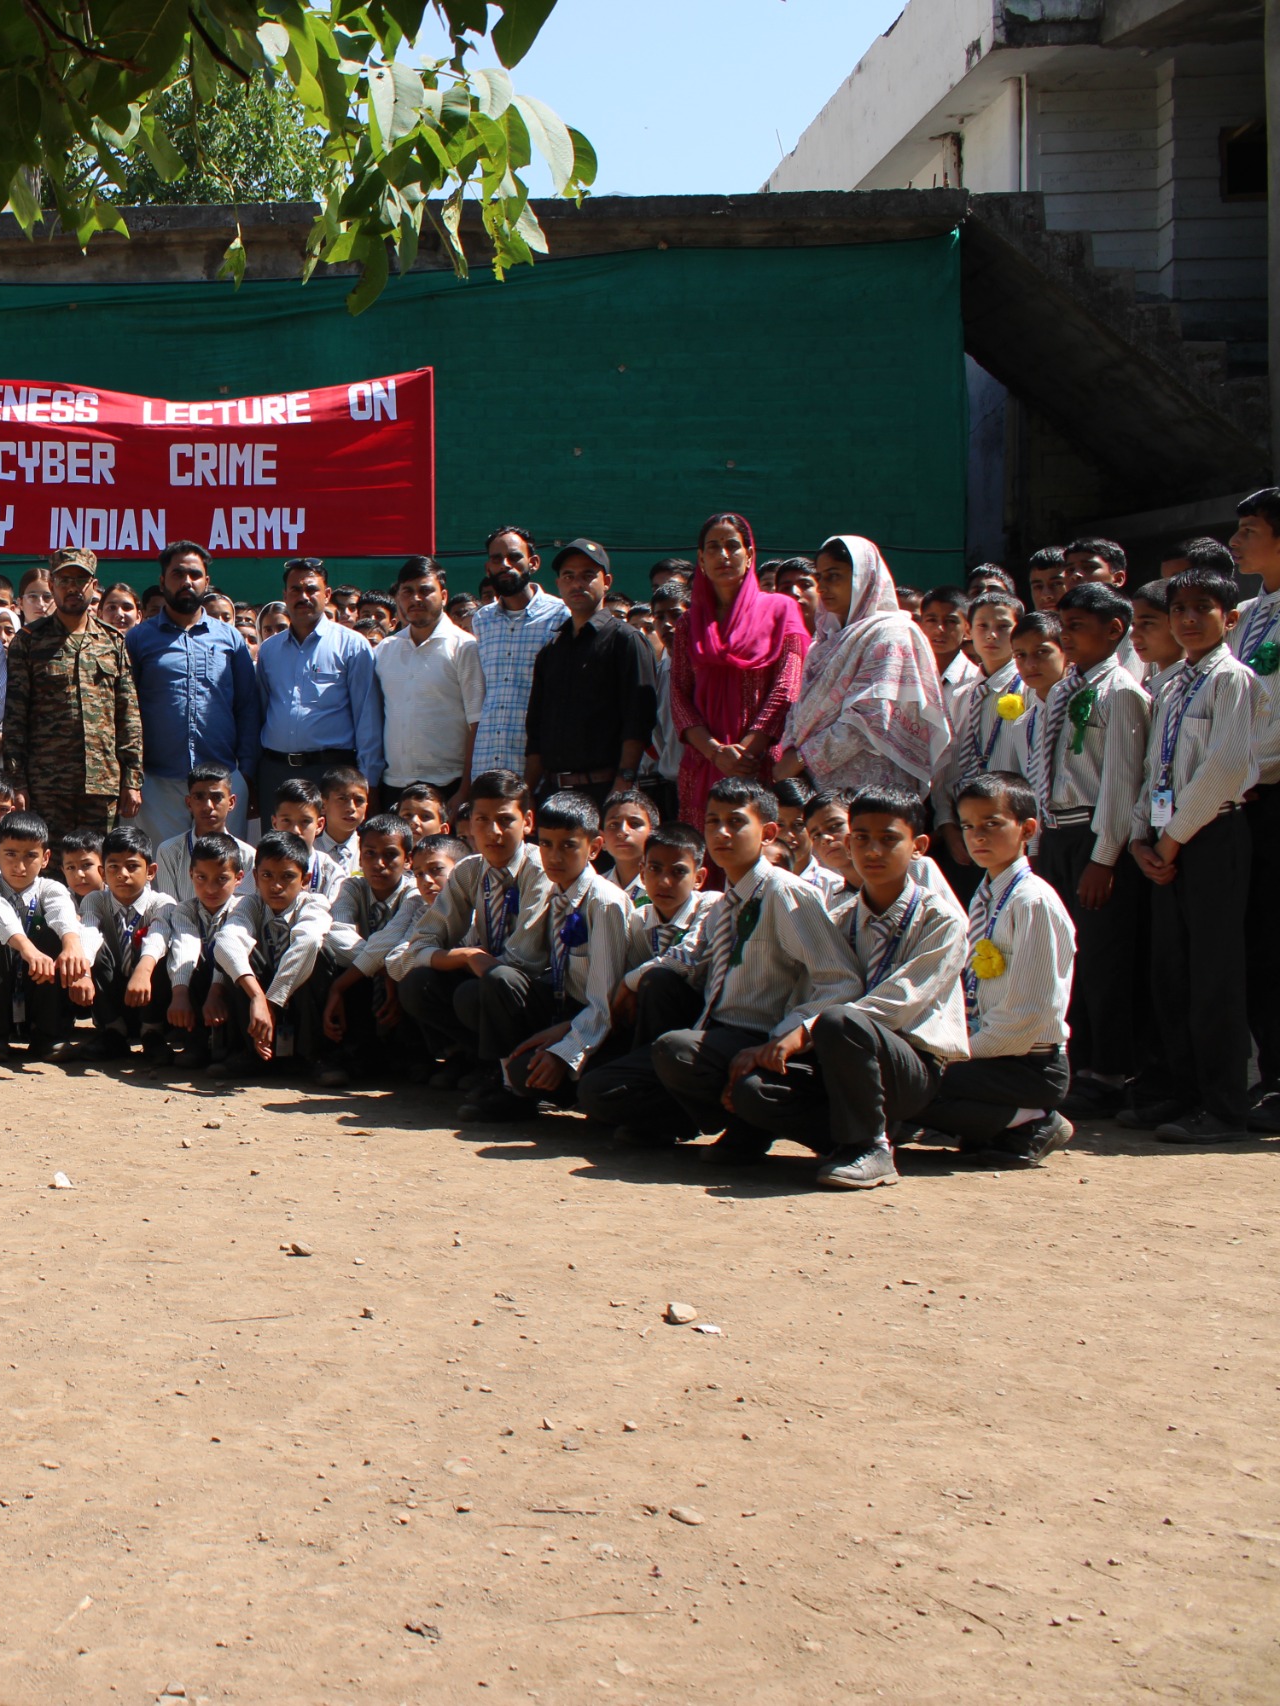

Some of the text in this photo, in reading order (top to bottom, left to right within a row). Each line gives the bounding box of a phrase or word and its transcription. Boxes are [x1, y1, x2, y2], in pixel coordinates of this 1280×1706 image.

[143, 392, 312, 424] LECTURE
[348, 380, 397, 421] ON
[169, 443, 278, 486] CRIME
[49, 507, 166, 550] INDIAN
[208, 506, 306, 549] ARMY
